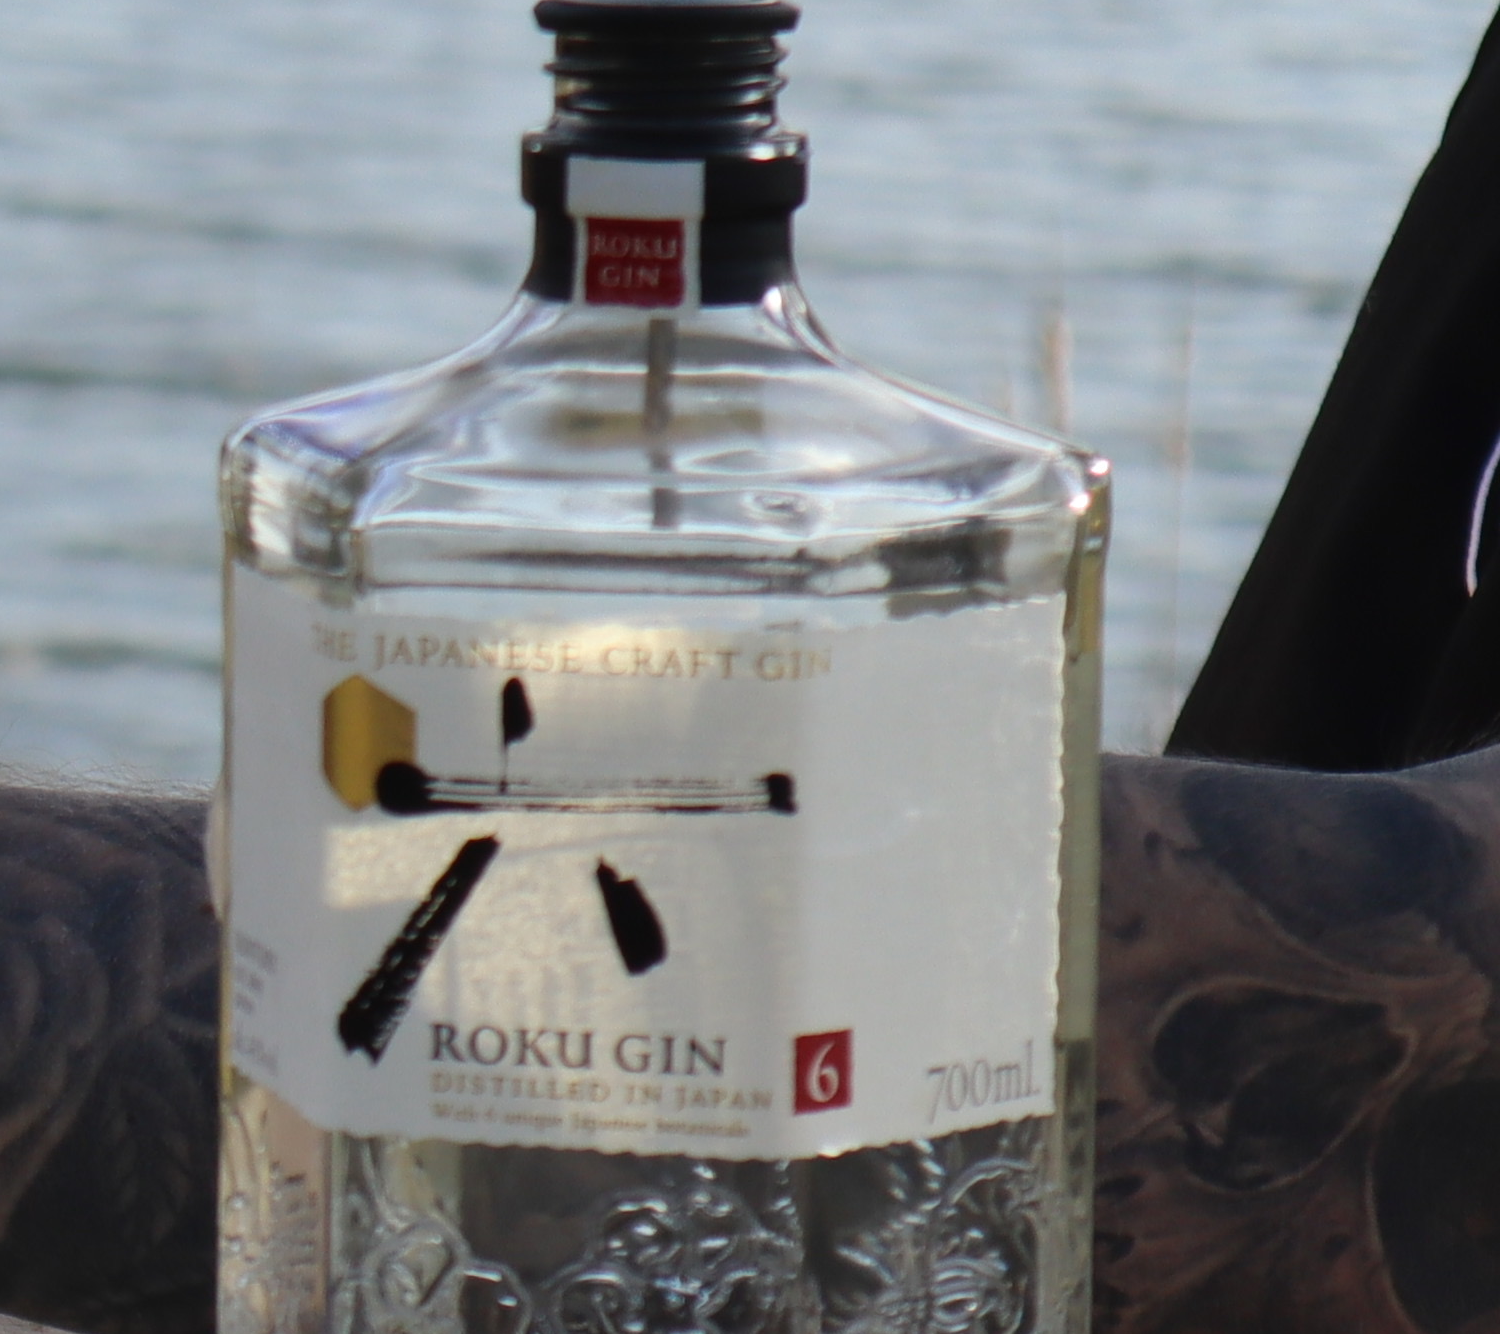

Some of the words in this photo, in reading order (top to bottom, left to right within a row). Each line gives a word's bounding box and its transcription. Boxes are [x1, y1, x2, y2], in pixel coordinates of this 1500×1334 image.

[589, 234, 679, 260] ROKU
[598, 267, 661, 288] GIN
[372, 632, 584, 673] JAPANESE
[599, 641, 742, 681] CRAFT
[753, 645, 833, 683] GIN
[430, 1022, 595, 1069] ROKU
[614, 1033, 727, 1078] GIN
[807, 1040, 840, 1104] 6
[431, 1071, 611, 1104] DISTILLED
[625, 1082, 663, 1106] IN
[675, 1084, 774, 1113] JAPAN
